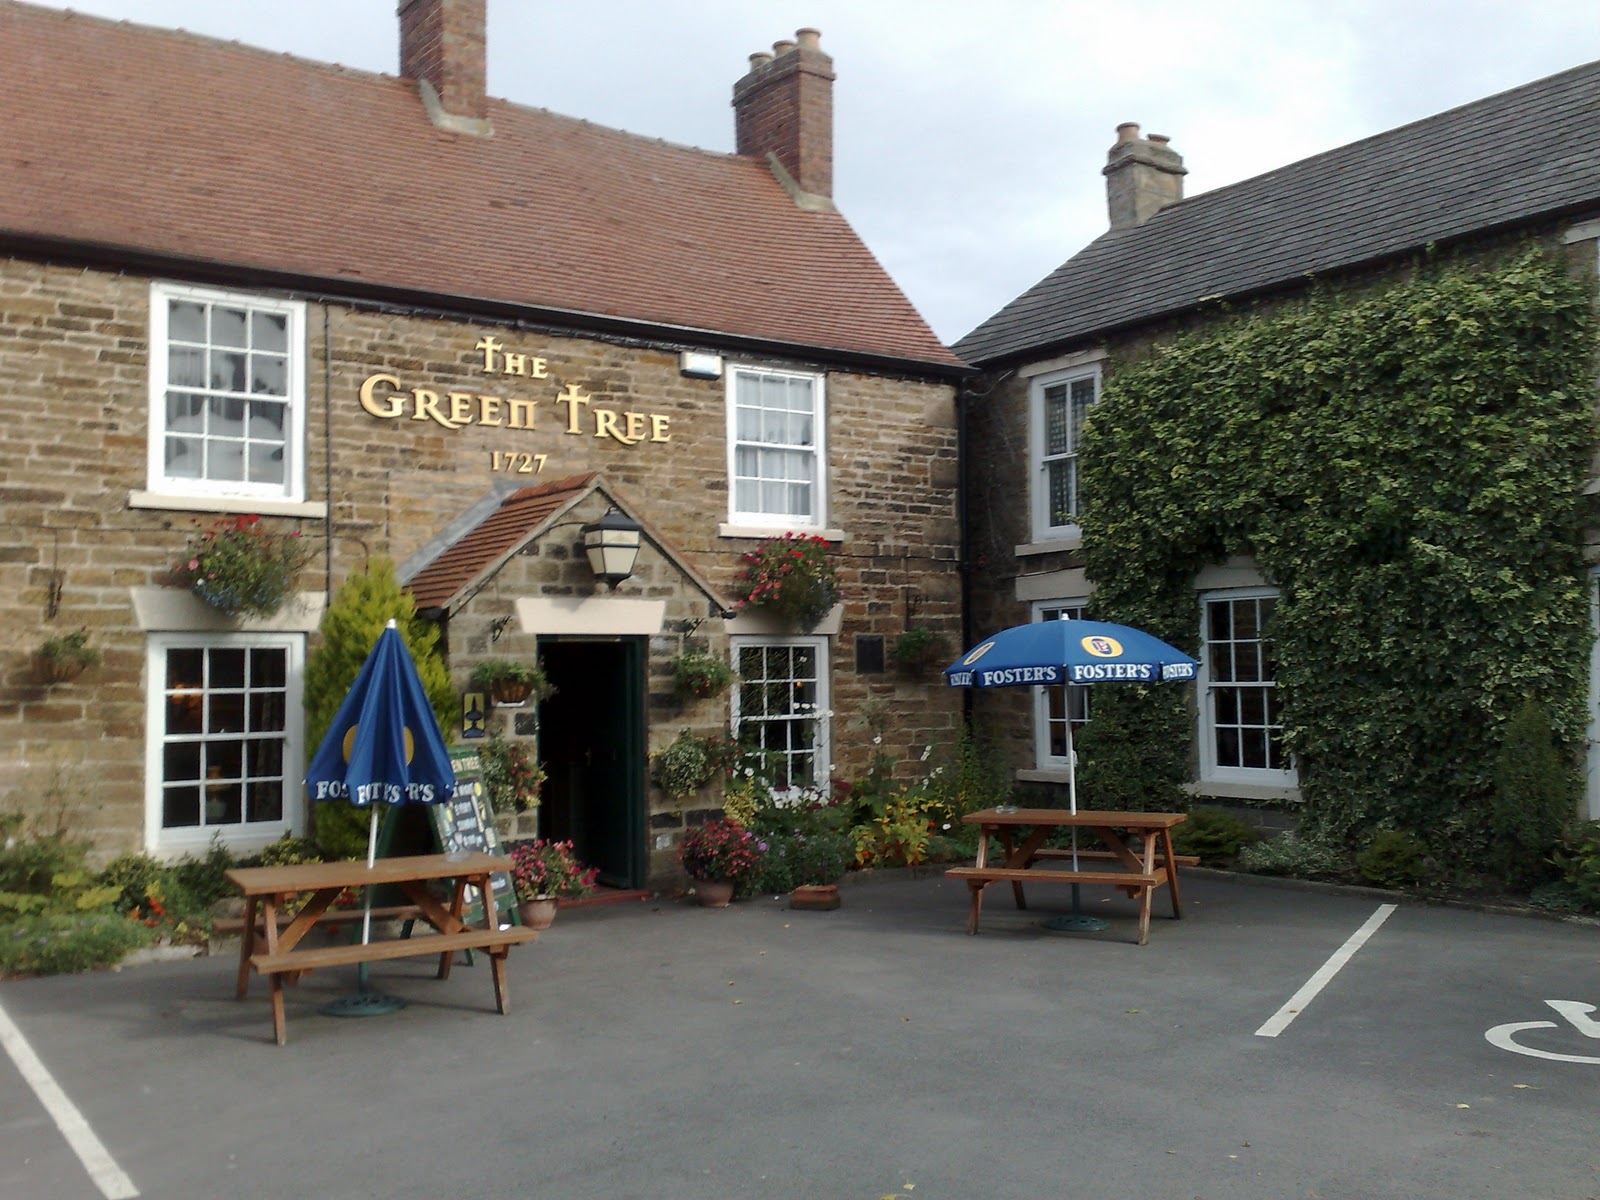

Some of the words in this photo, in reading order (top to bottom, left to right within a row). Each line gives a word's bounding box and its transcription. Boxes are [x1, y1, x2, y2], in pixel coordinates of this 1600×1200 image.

[475, 335, 549, 380] THE
[359, 373, 538, 430] GREEN
[555, 383, 672, 445] TREE
[491, 450, 548, 474] 1727
[983, 666, 1057, 686] FOSTER'S
[1074, 663, 1153, 680] FOSTER'S
